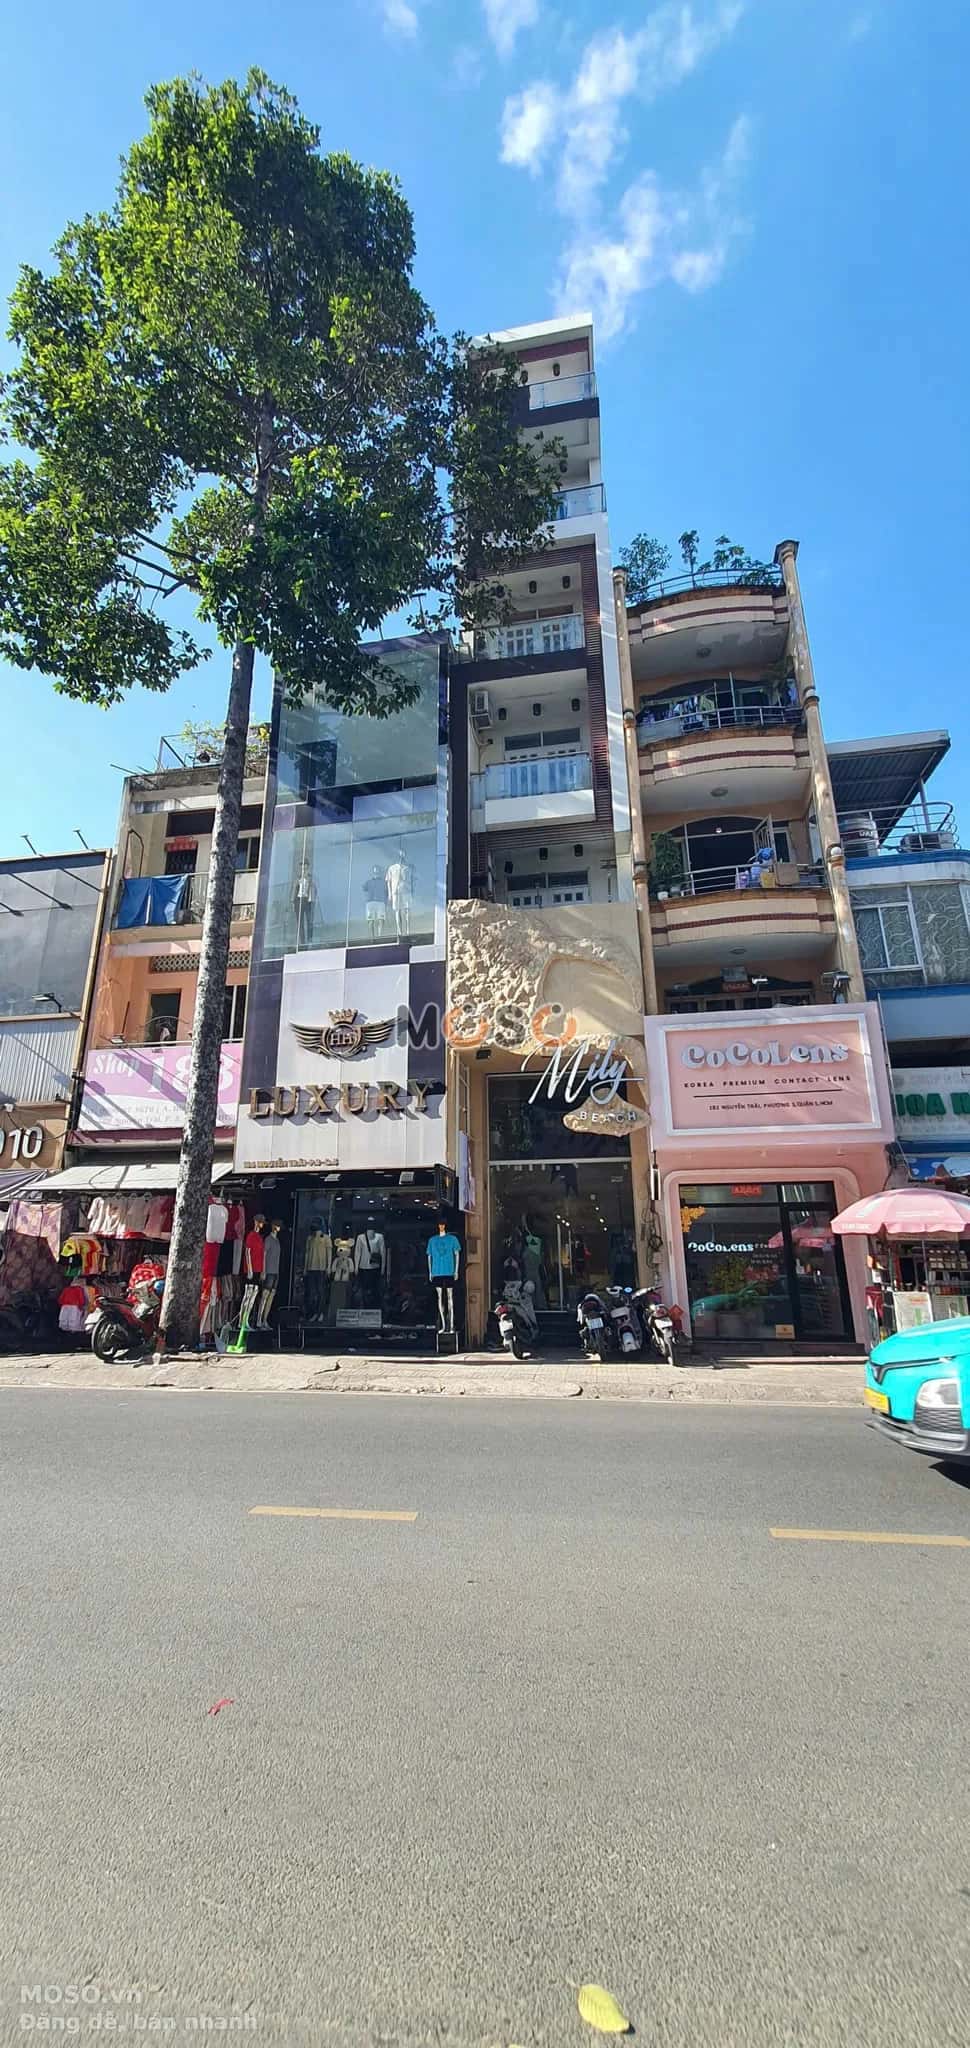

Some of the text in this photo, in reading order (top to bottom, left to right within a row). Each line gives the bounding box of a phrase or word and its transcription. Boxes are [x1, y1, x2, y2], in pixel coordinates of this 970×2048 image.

[93, 1053, 140, 1077] Shop
[681, 1038, 850, 1070] CoCoLens
[520, 1038, 645, 1105] Mily
[683, 1081, 715, 1089] KOREA
[722, 1079, 766, 1087] PREMIUM
[774, 1076, 820, 1085] CONTACT
[247, 1078, 438, 1120] LUXURY
[578, 1109, 639, 1124] BEACH
[0, 1126, 43, 1160] 10
